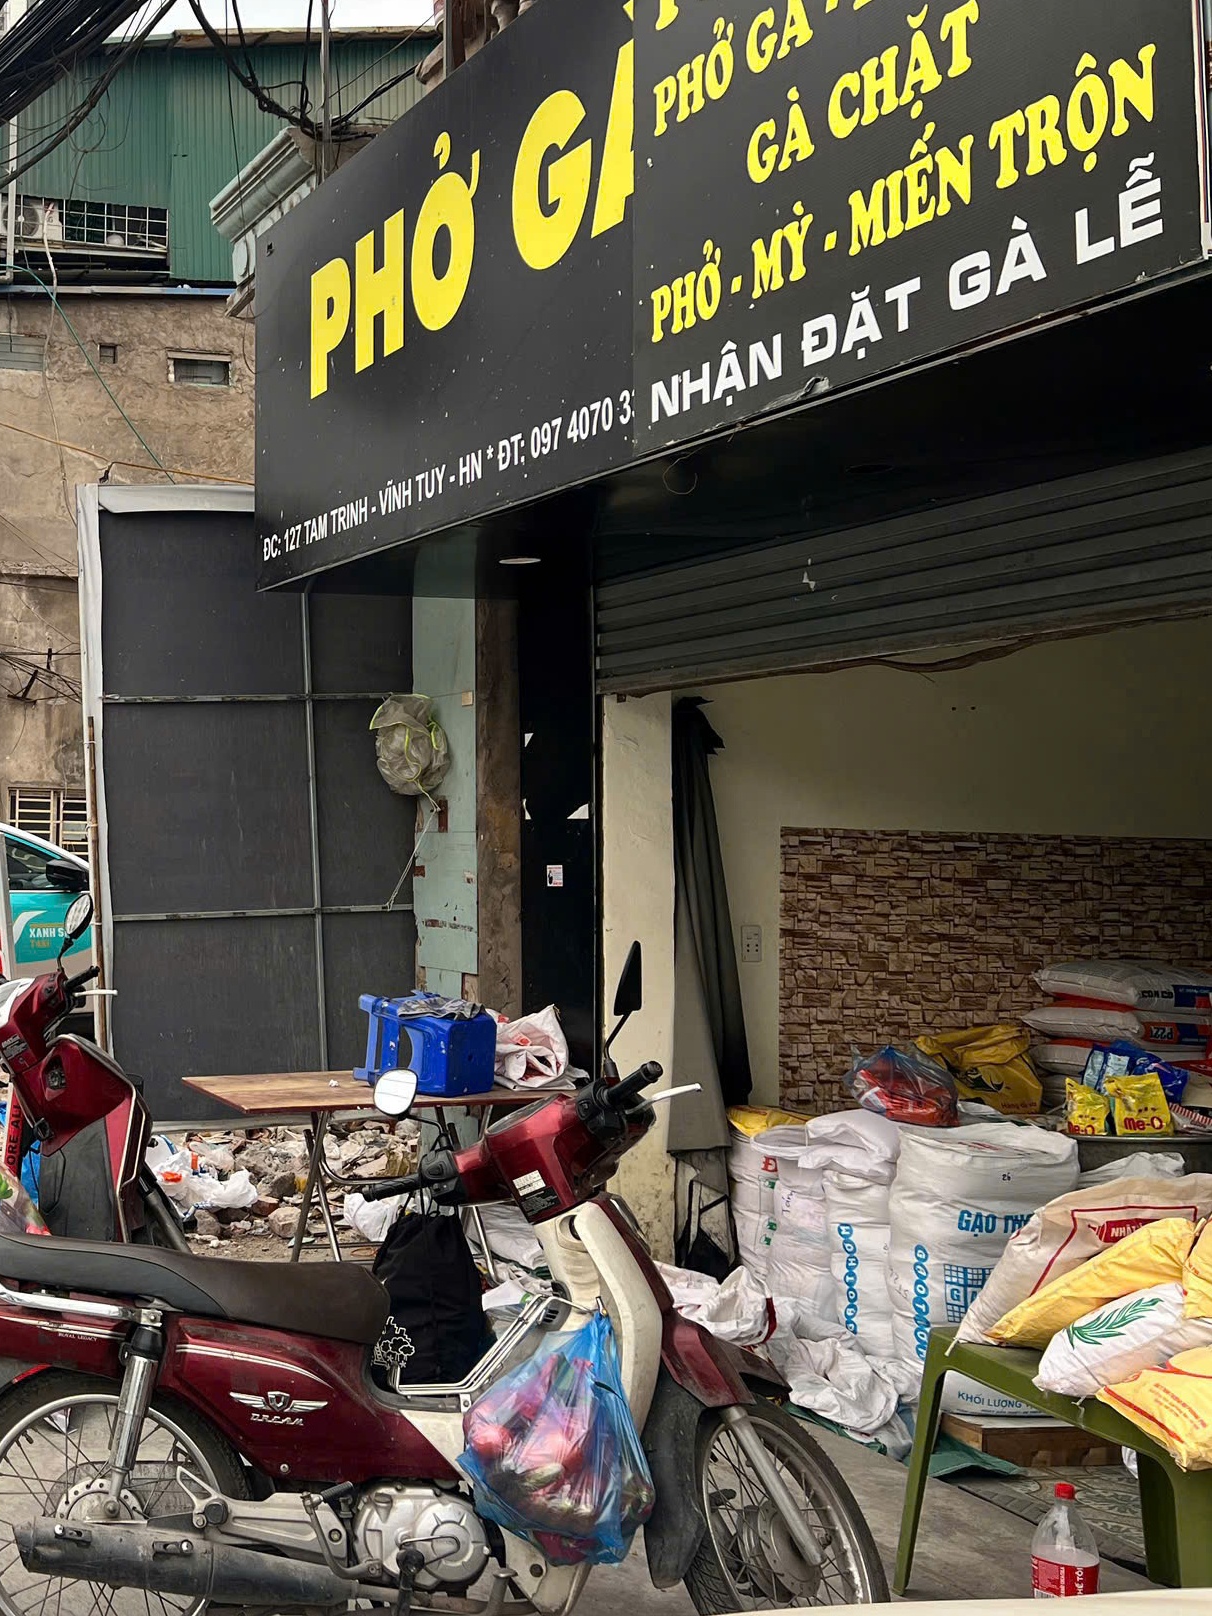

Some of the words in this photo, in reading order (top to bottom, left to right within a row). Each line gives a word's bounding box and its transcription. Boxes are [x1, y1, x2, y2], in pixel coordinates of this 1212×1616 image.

[655, 18, 735, 137] PHỞ
[747, 87, 815, 183] GÀ
[829, 0, 980, 139] CHẶT
[651, 240, 722, 343] PHỞ
[847, 122, 975, 257] MIẾN
[989, 44, 1157, 189] TRỘN
[311, 131, 480, 399] PHỞ
[651, 334, 782, 424] NHẬN
[801, 277, 921, 368] ĐẶT
[948, 215, 1047, 311] GÀ
[1074, 151, 1163, 265] LỄ
[263, 535, 281, 561] ĐC:
[284, 524, 302, 553] 127
[304, 513, 328, 546] TAM
[330, 497, 368, 535] TRINH
[378, 479, 412, 516] VĨNH
[415, 464, 447, 502] TUY
[459, 449, 482, 487] HN
[497, 432, 525, 472] ĐT:
[530, 417, 563, 459] 097
[566, 397, 613, 443] 4070
[619, 389, 635, 425] 3
[29, 927, 56, 939] XANH
[1123, 1116, 1163, 1131] Me-O
[957, 1209, 997, 1237] GẠO
[250, 1413, 304, 1426] DREAM
[957, 1391, 985, 1406] KHỐI
